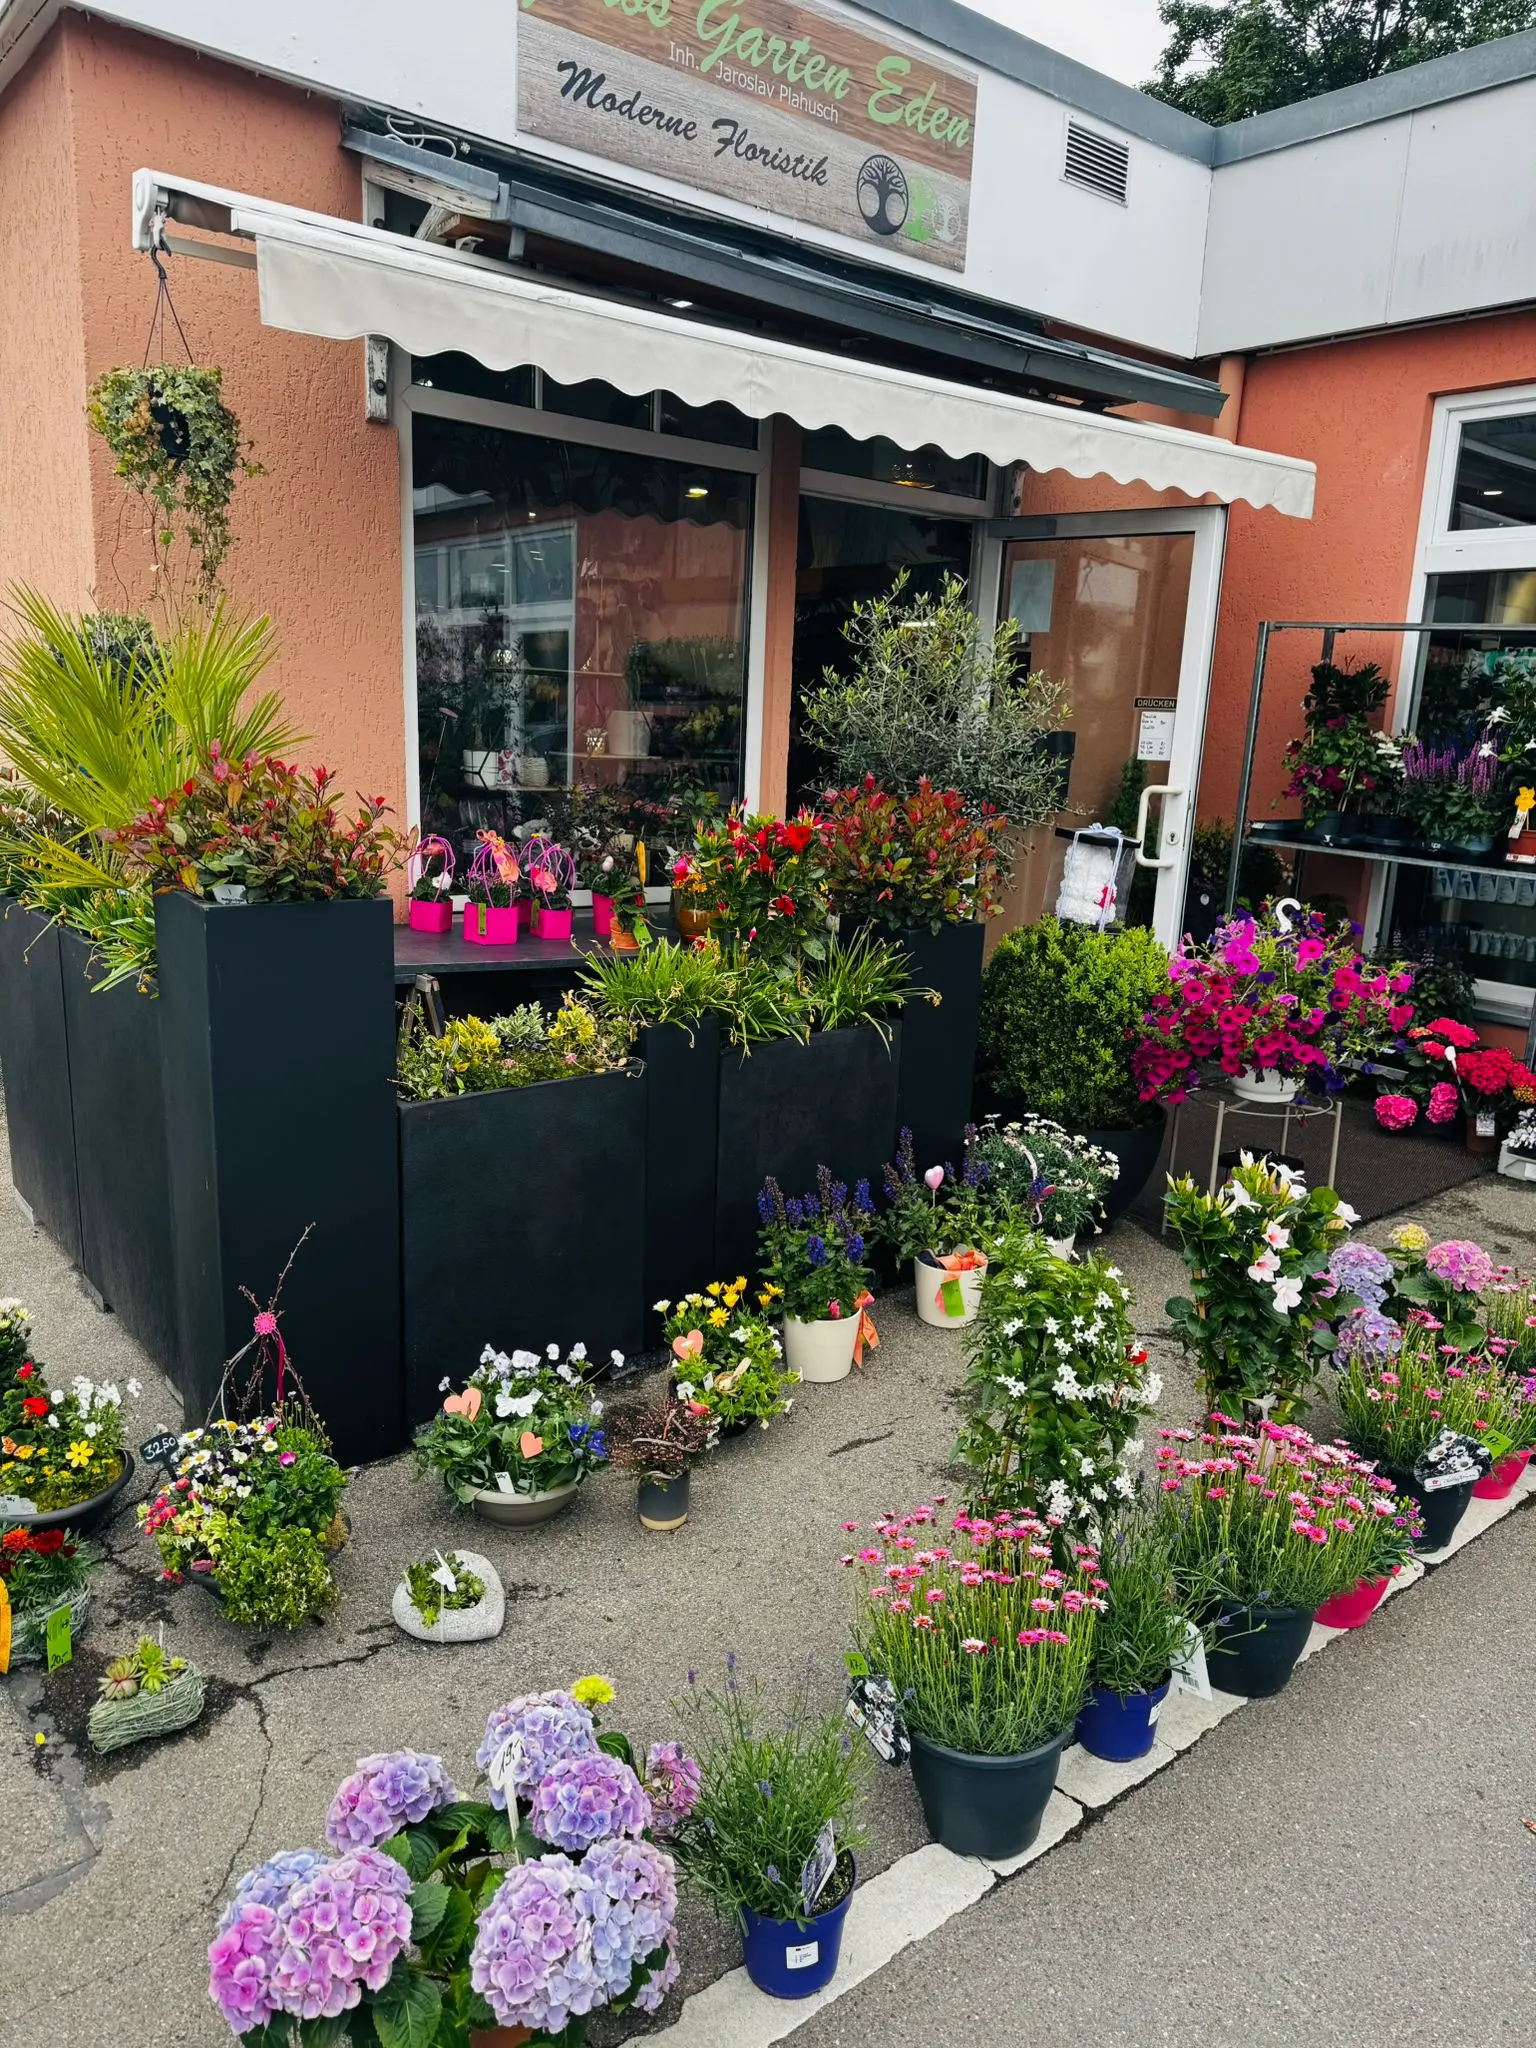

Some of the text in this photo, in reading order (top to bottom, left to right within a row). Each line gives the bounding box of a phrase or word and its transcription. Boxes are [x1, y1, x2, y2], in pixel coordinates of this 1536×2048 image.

[557, 60, 829, 186] Moderne Floristik
[668, 40, 839, 124] Inh. Jaroslav Plahusch
[695, 0, 970, 148] Garten Eden
